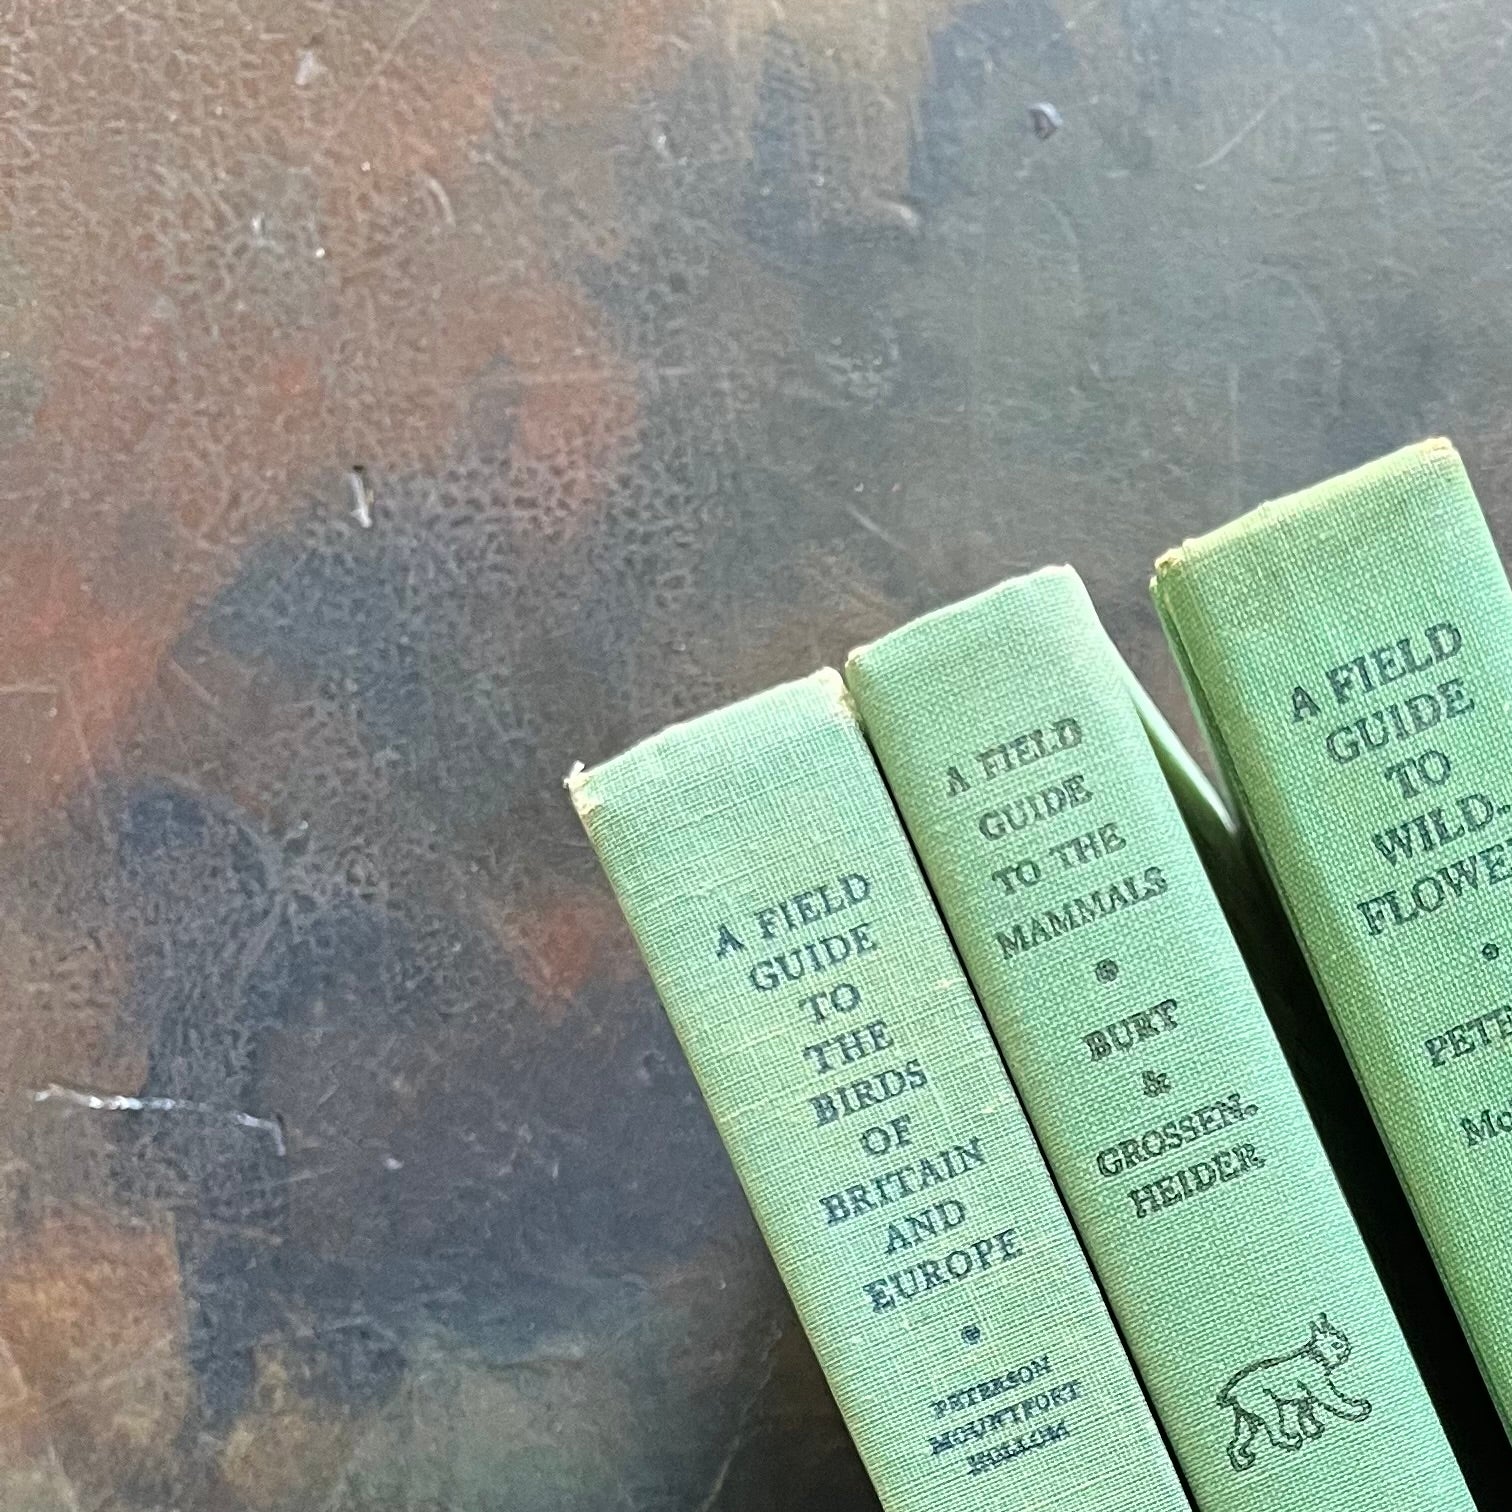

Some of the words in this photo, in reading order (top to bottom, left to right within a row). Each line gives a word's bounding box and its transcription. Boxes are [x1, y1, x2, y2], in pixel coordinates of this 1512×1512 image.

[1290, 685, 1321, 724] A
[1325, 621, 1464, 704] FIELD
[1325, 677, 1475, 765] GUIDE
[945, 766, 970, 799] A
[977, 718, 1084, 784] FIELD
[1383, 748, 1452, 800] TO
[978, 774, 1094, 842] GUIDE
[990, 857, 1042, 896] TO
[1049, 822, 1127, 876] THE
[714, 926, 745, 960] A
[760, 873, 872, 941] FIELD
[995, 866, 1170, 960] MAMMALS
[748, 922, 878, 992] GUIDE
[799, 980, 862, 1025] TO
[1082, 999, 1179, 1063] BURT
[803, 1019, 895, 1074] THE
[809, 1059, 928, 1128] BIRDS
[1141, 1069, 1172, 1098] &
[860, 1113, 912, 1157] OF
[819, 1136, 987, 1227] BRITAIN
[1128, 1144, 1267, 1219] HEIDER
[884, 1199, 967, 1255] AND
[862, 1228, 1024, 1313] EUROPE
